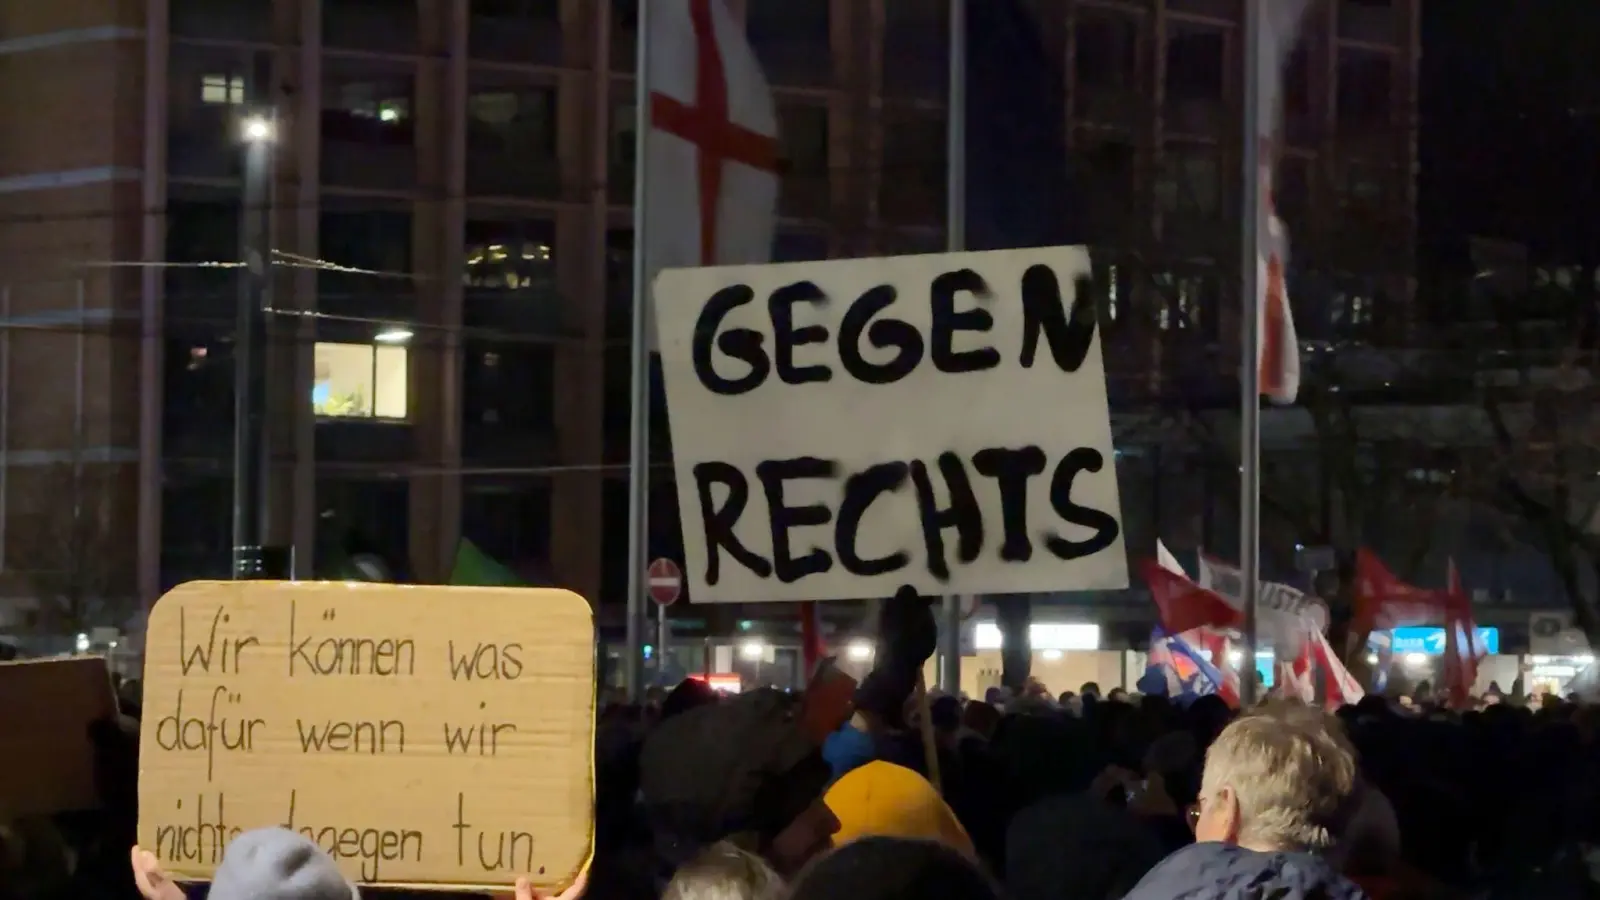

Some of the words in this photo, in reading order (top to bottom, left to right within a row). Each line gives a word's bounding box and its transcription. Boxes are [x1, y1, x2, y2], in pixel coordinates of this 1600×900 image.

[692, 264, 1097, 395] GEGEN
[693, 445, 1119, 585] RECHTS
[180, 605, 259, 676] Wir
[289, 600, 414, 676] können
[449, 640, 523, 681] was
[156, 685, 265, 781] dafür
[297, 718, 404, 754] wenn
[444, 701, 516, 756] wir
[156, 793, 243, 863] nicht
[453, 792, 546, 874] tun.
